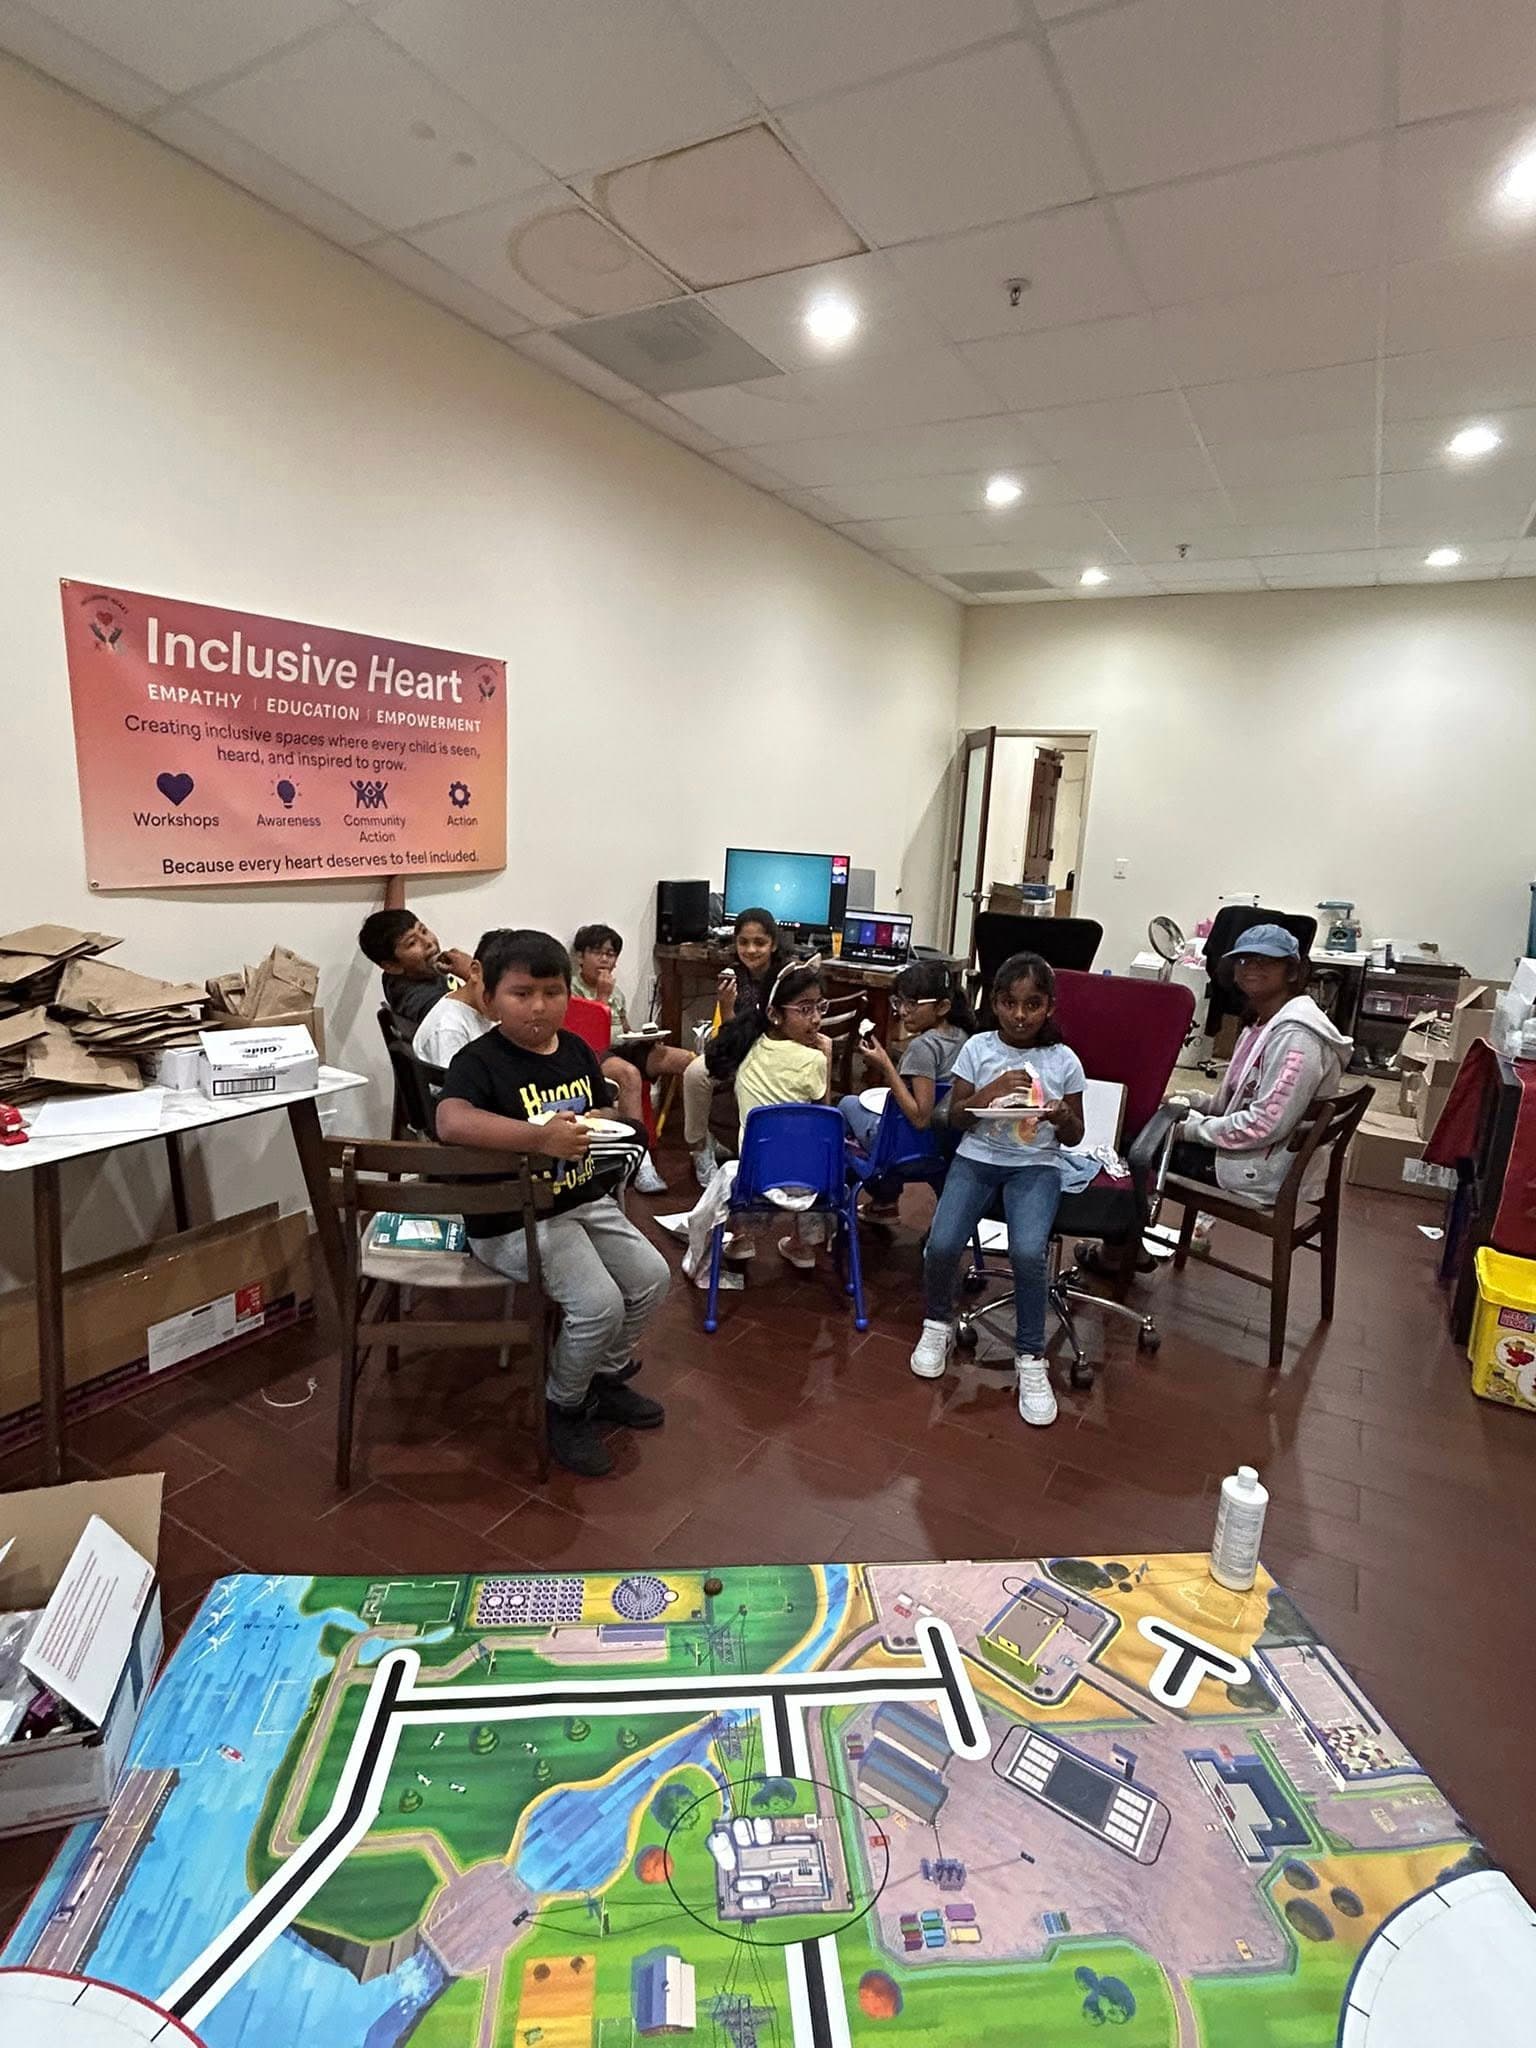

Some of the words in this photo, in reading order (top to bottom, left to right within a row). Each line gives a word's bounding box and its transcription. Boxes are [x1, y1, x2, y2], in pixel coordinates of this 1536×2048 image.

[148, 617, 358, 690] Inclusive
[367, 655, 463, 704] Heart
[147, 684, 242, 709] EMPATHY
[266, 698, 360, 721] EDUCATION
[376, 710, 481, 733] EMPOWERMENT
[124, 715, 201, 741] Creating
[205, 722, 272, 743] inclusive
[275, 731, 324, 748] spaces
[327, 734, 369, 750] where
[371, 740, 406, 755] every
[408, 740, 437, 755] child
[439, 742, 449, 755] is
[450, 745, 481, 760] seen,
[216, 745, 265, 765] heard,
[268, 751, 295, 766] and
[297, 752, 352, 770] inspired
[356, 757, 370, 770] to
[372, 760, 408, 774] grow.
[133, 812, 220, 829] Workshops
[256, 814, 322, 828] Awareness
[343, 814, 406, 830] Community
[447, 815, 478, 827] Action
[359, 831, 397, 844] Action
[162, 859, 235, 874] Because
[238, 858, 282, 874] every
[285, 855, 324, 870] heart
[326, 854, 388, 868] deserves
[390, 853, 404, 865] to
[406, 851, 427, 865] feel
[429, 850, 480, 864] included.
